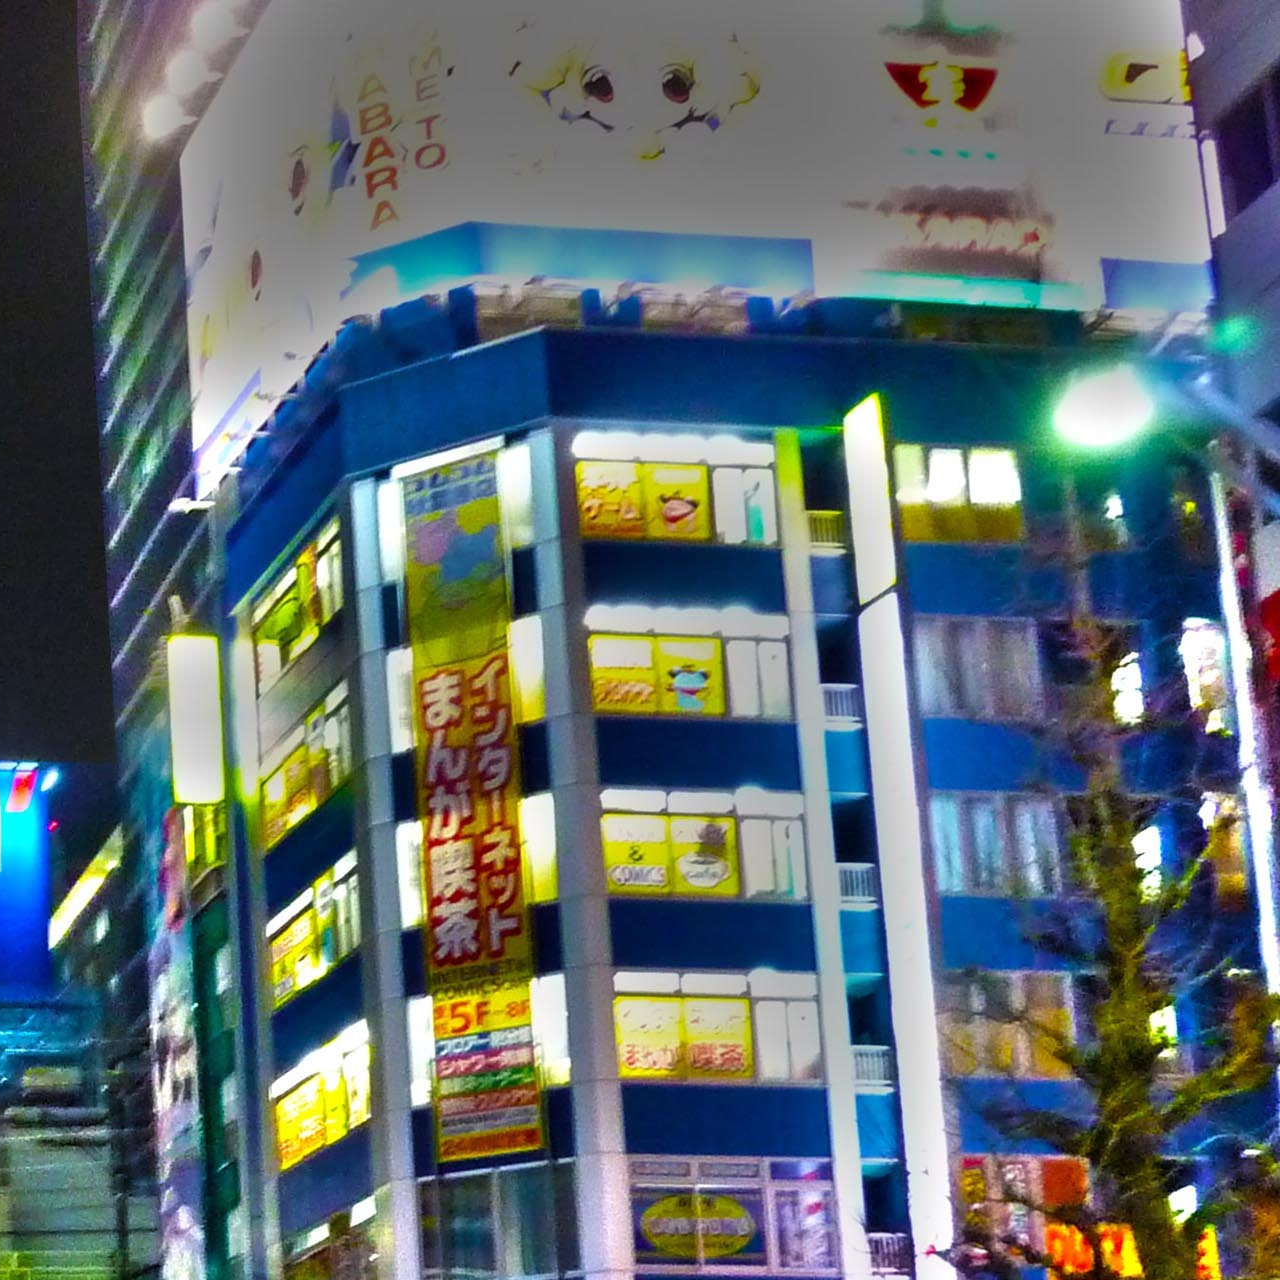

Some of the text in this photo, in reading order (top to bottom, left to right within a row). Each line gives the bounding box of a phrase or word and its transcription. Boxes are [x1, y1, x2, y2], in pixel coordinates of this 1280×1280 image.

[420, 672, 481, 965] まんが喫茶
[470, 655, 523, 955] インターネット
